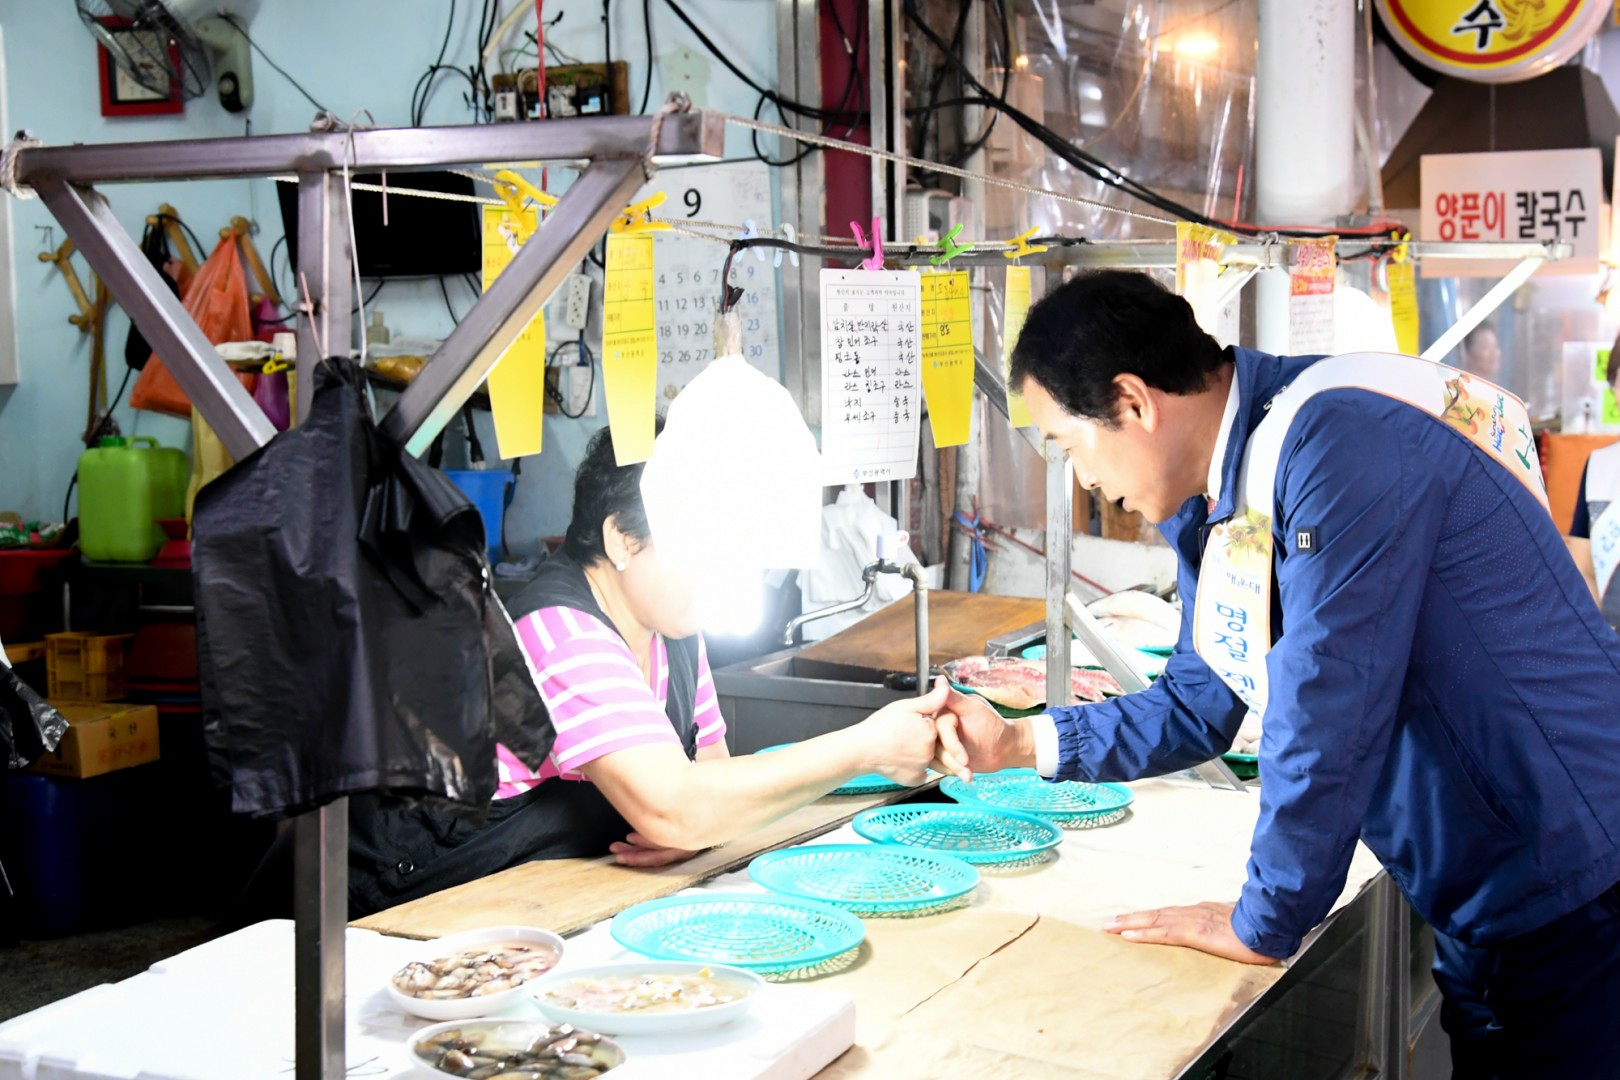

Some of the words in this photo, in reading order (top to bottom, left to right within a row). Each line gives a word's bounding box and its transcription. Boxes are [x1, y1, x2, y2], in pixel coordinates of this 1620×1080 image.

[1453, 0, 1503, 49] 수
[684, 188, 702, 218] 9
[1436, 192, 1505, 241] 양푼이
[1516, 189, 1586, 239] 칼국수
[658, 274, 666, 285] 4
[676, 273, 684, 284] 5
[693, 272, 701, 283] 6
[712, 269, 719, 281] 7
[748, 266, 755, 277] 9
[658, 300, 669, 311] 11
[676, 299, 687, 310] 12
[694, 298, 705, 309] 13
[746, 293, 759, 305] 16
[660, 326, 671, 337] 18
[677, 325, 689, 336] 19
[694, 323, 708, 335] 20
[747, 319, 760, 331] 23
[661, 352, 673, 363] 25
[678, 350, 691, 362] 26
[695, 349, 708, 361] 27
[750, 345, 762, 357] 30
